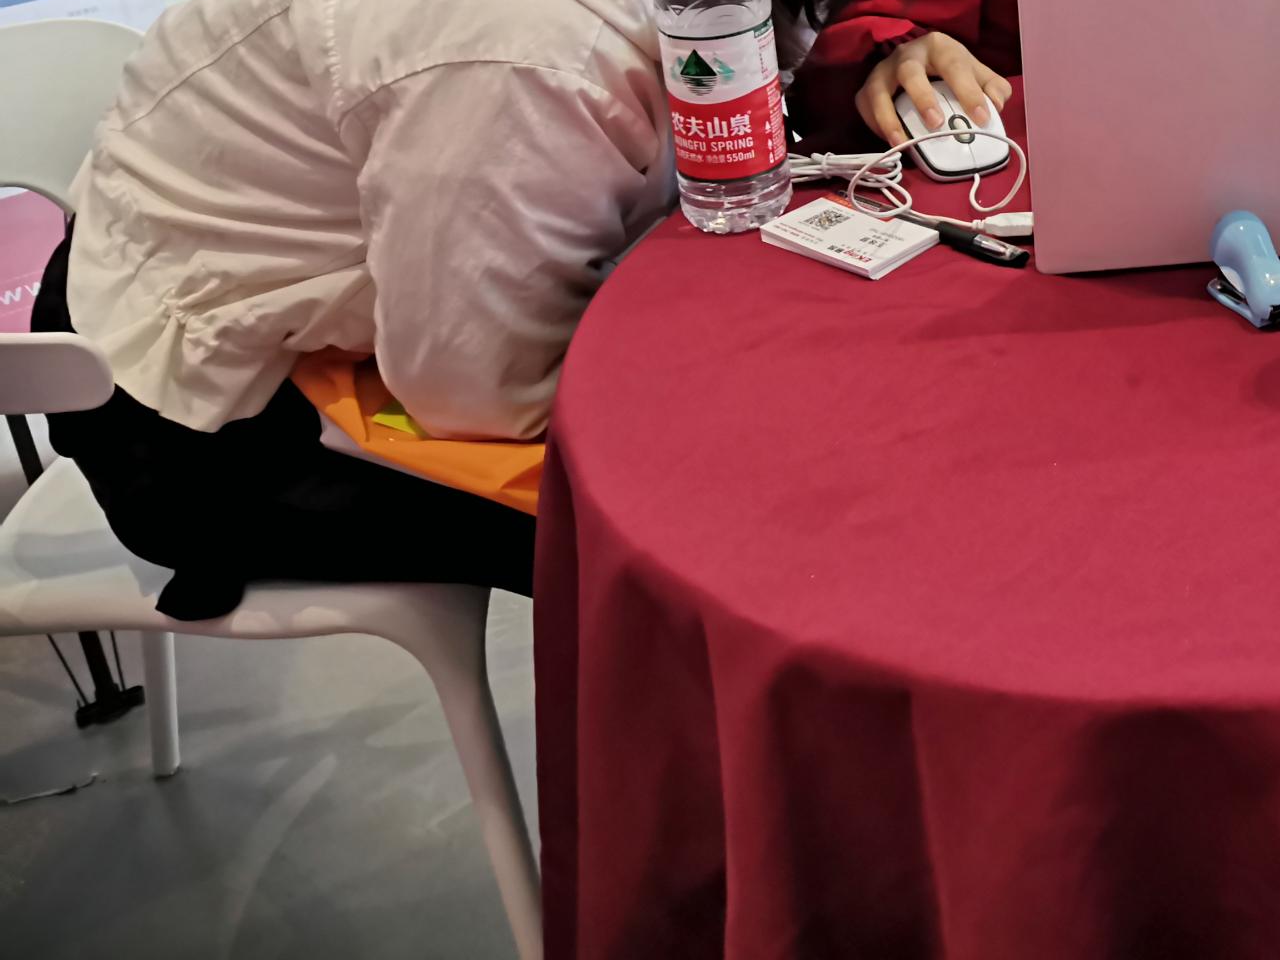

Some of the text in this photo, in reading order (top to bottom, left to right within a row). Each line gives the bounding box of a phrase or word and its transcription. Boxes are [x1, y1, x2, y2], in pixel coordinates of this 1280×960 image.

[671, 111, 752, 139] 农夫山泉
[710, 136, 754, 153] SPRING
